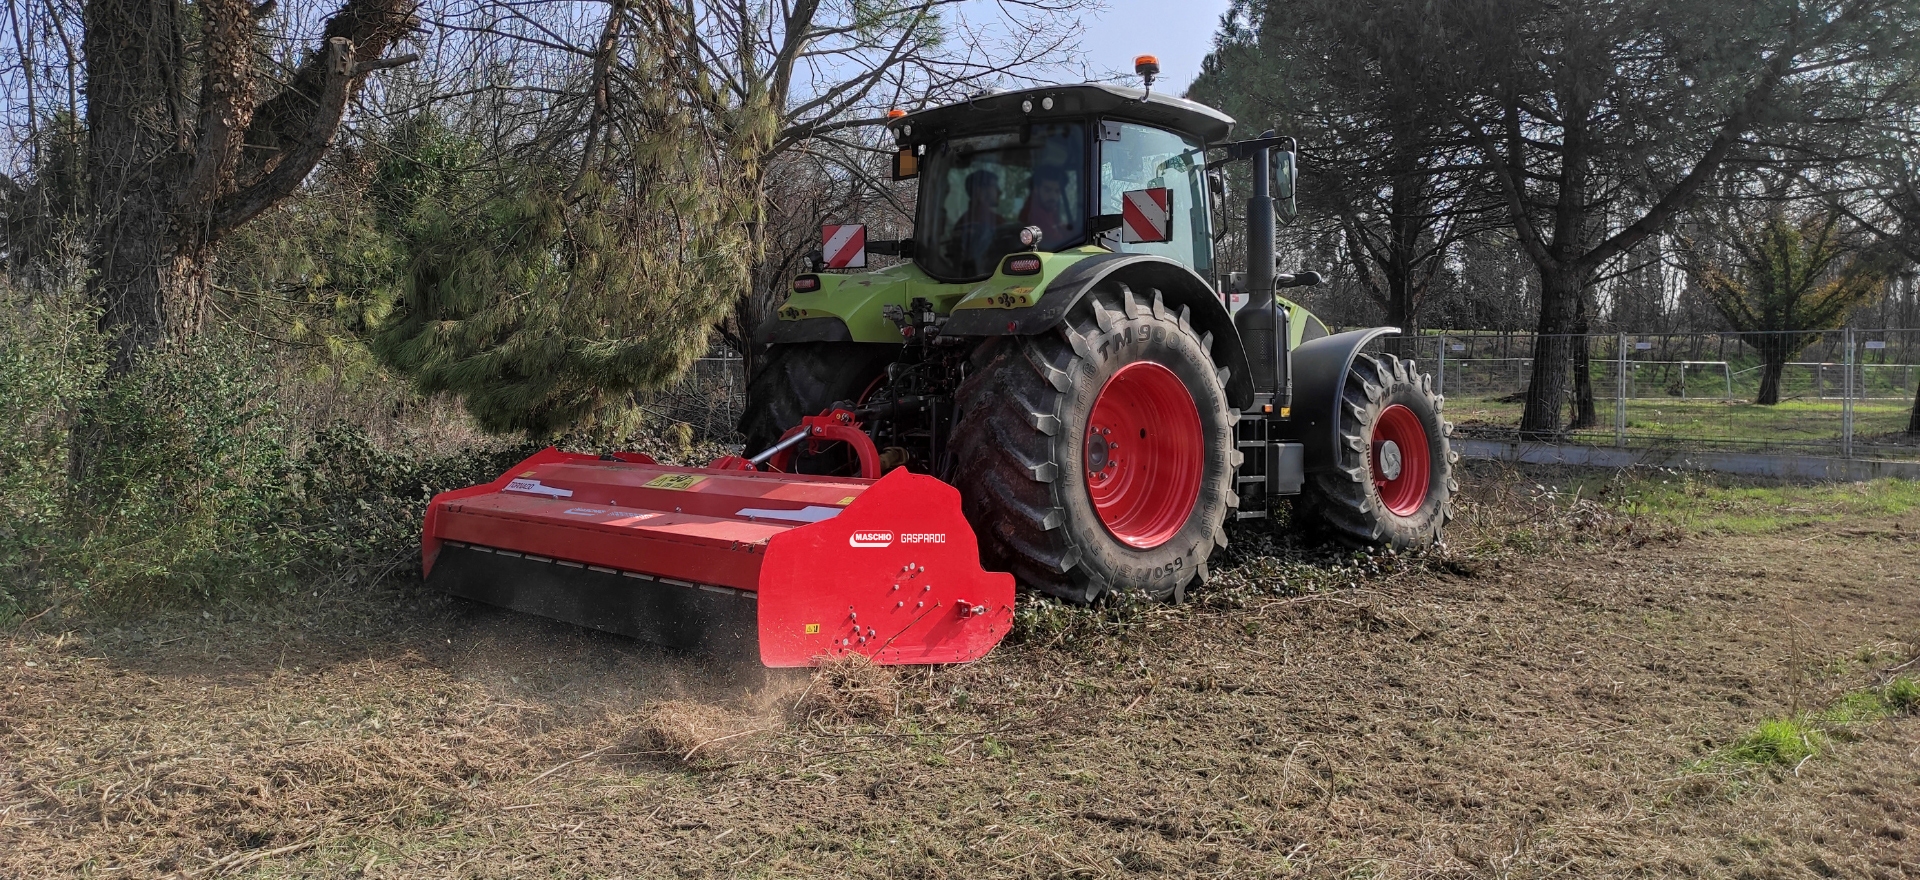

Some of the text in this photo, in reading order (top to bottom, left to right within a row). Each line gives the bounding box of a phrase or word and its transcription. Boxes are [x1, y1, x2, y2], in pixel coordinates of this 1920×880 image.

[1097, 326, 1132, 362] TM
[1137, 324, 1181, 349] 900
[1062, 363, 1097, 488] TRELLEBORG
[1200, 426, 1227, 540] TRELLEBORG
[855, 533, 946, 543] MASCHIO GASPARDO
